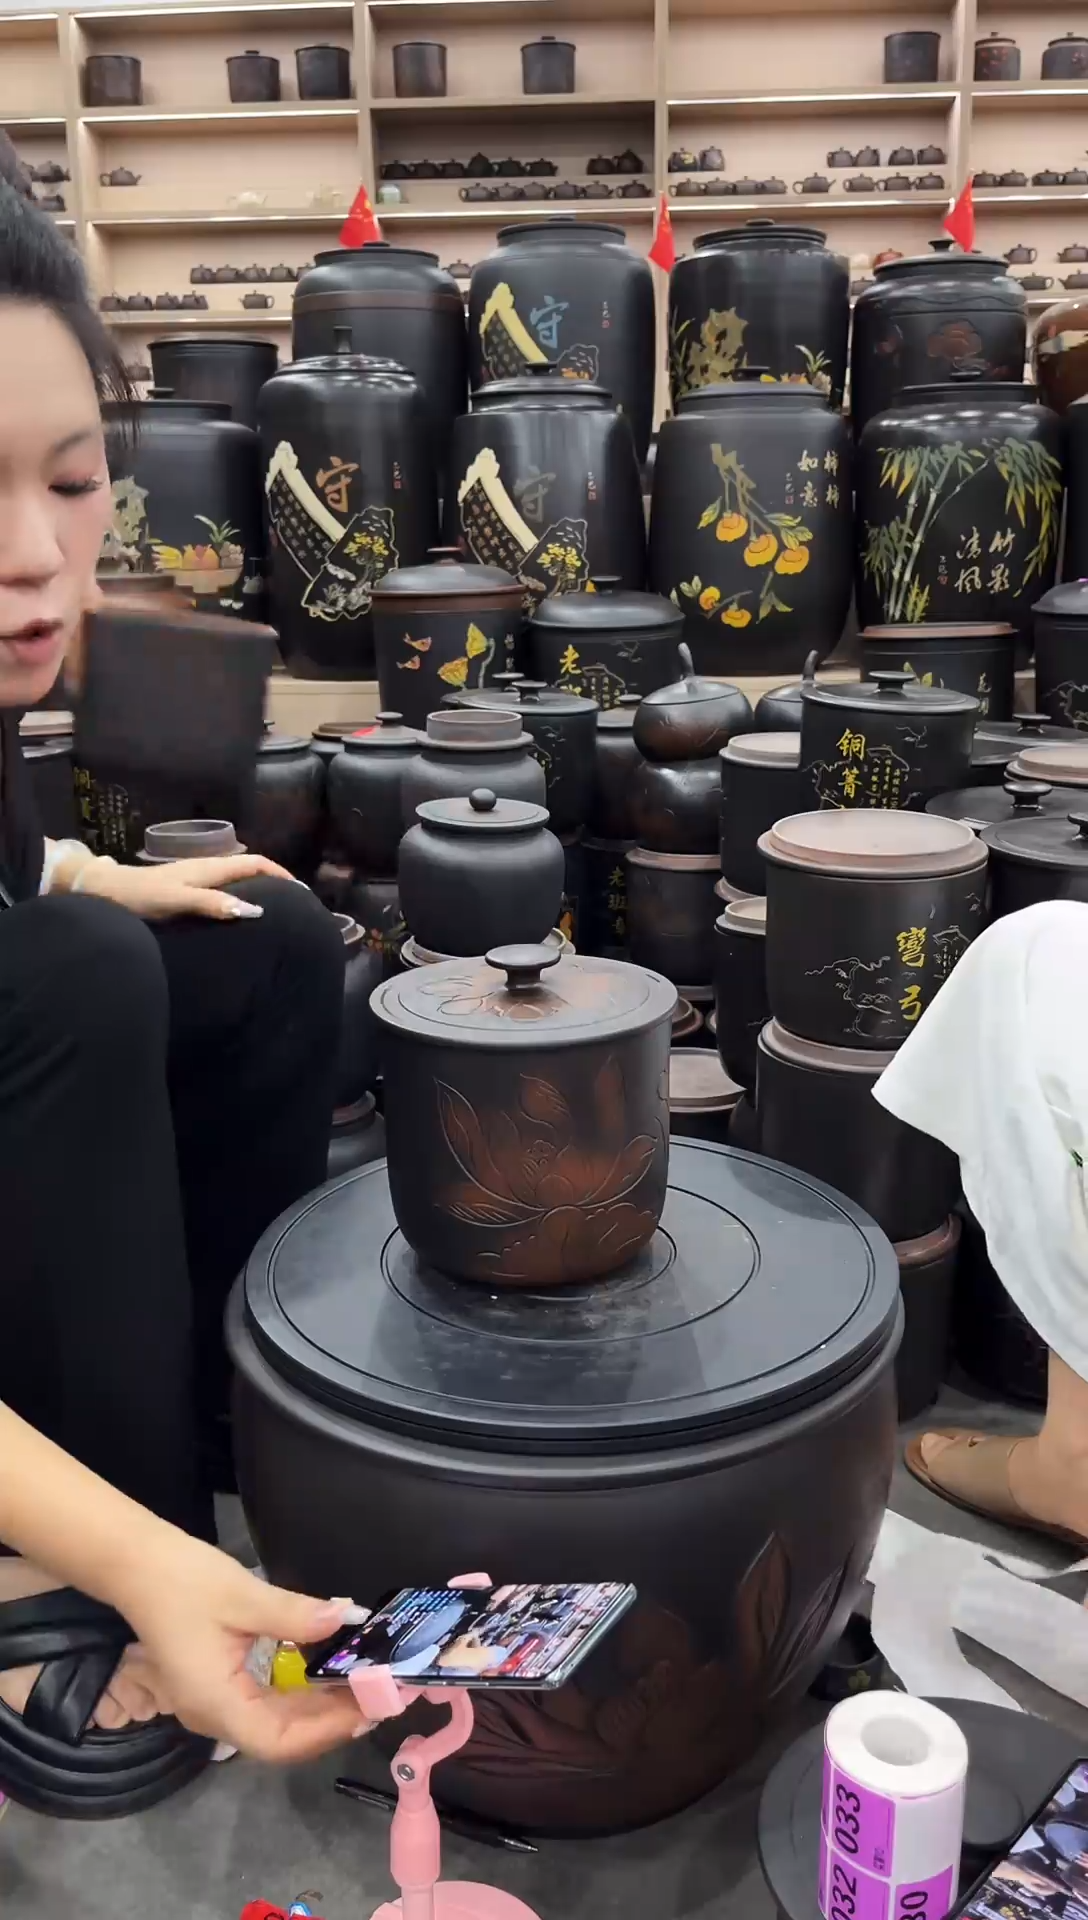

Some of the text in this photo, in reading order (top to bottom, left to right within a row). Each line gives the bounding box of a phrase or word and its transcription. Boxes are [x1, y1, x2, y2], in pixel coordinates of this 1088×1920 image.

[797, 449, 819, 508] 如意
[836, 728, 866, 809] 铜箐
[835, 1784, 861, 1854] 033
